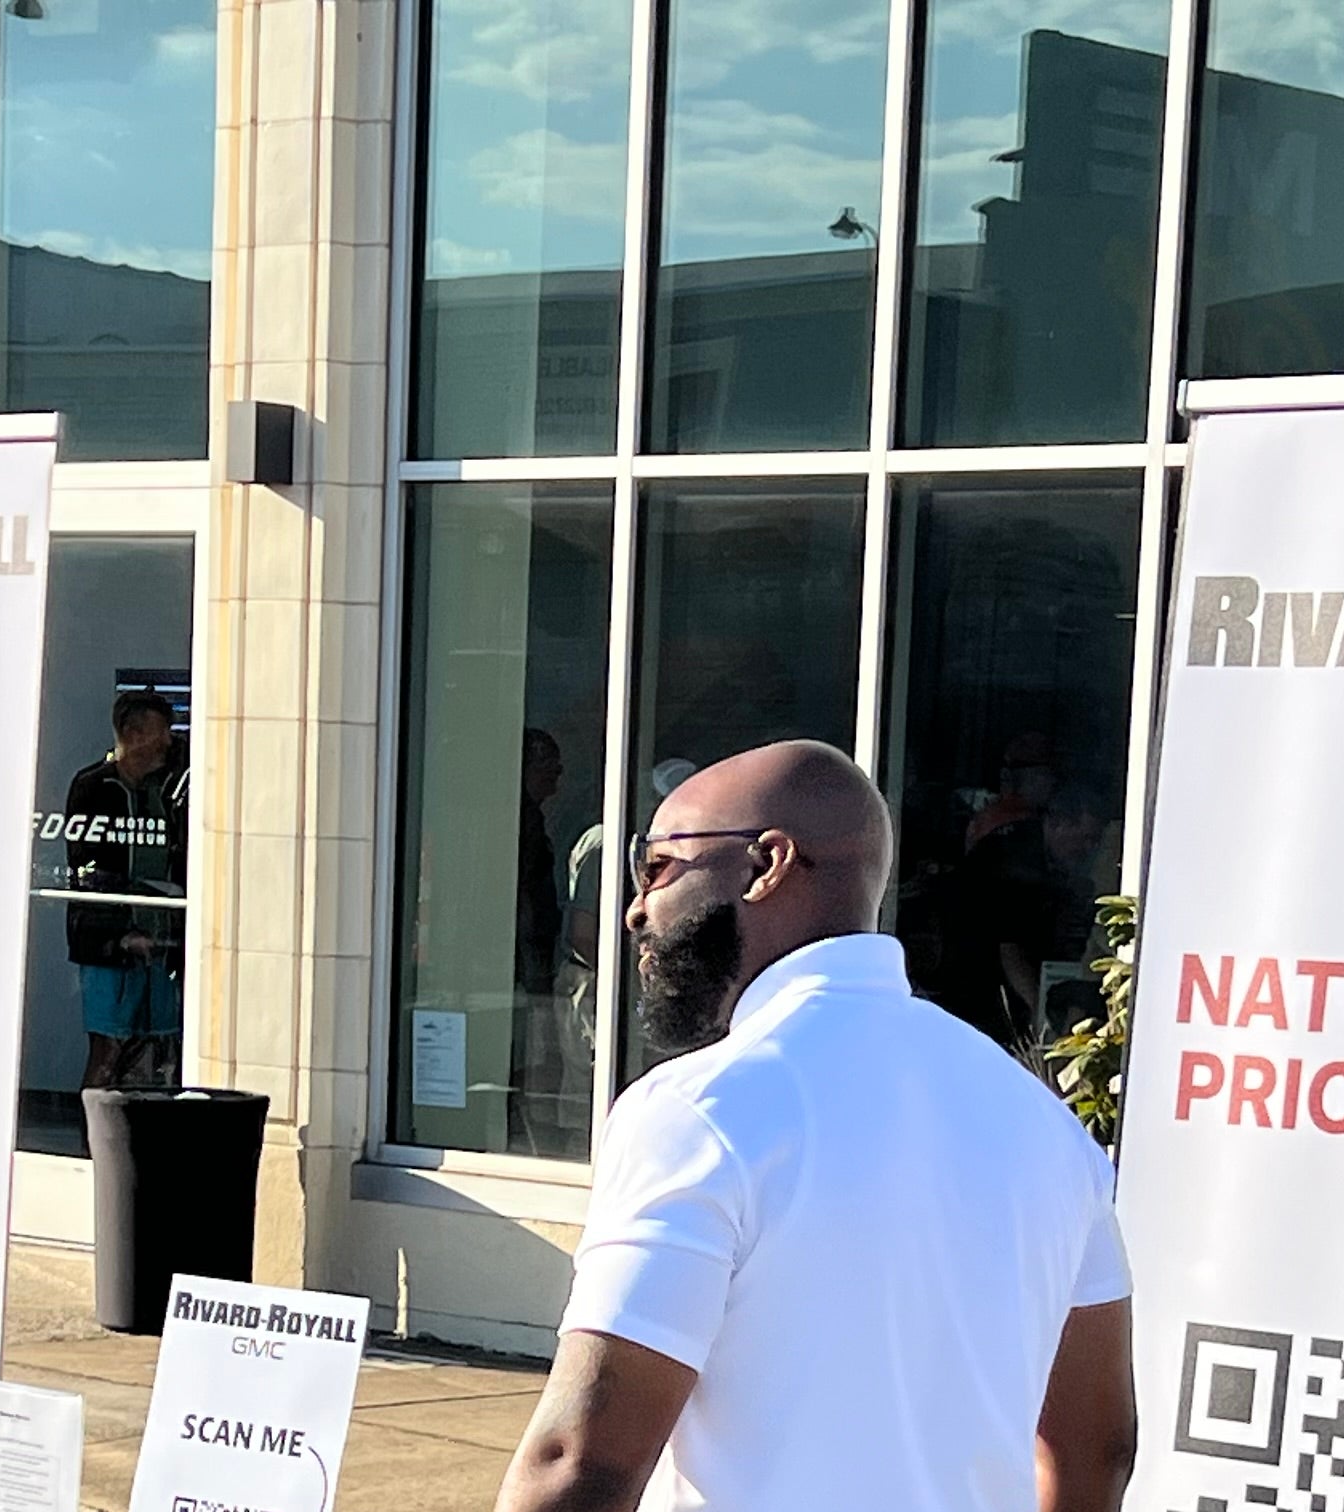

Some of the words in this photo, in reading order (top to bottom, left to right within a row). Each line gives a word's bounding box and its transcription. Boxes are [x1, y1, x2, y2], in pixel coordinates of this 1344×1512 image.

[114, 816, 167, 831] MOTOR
[106, 830, 167, 845] MUSEUM
[173, 1291, 357, 1343] RIVARD-ROYALL
[231, 1336, 286, 1360] GMC
[180, 1414, 253, 1450] SCAN
[260, 1425, 305, 1458] ME
